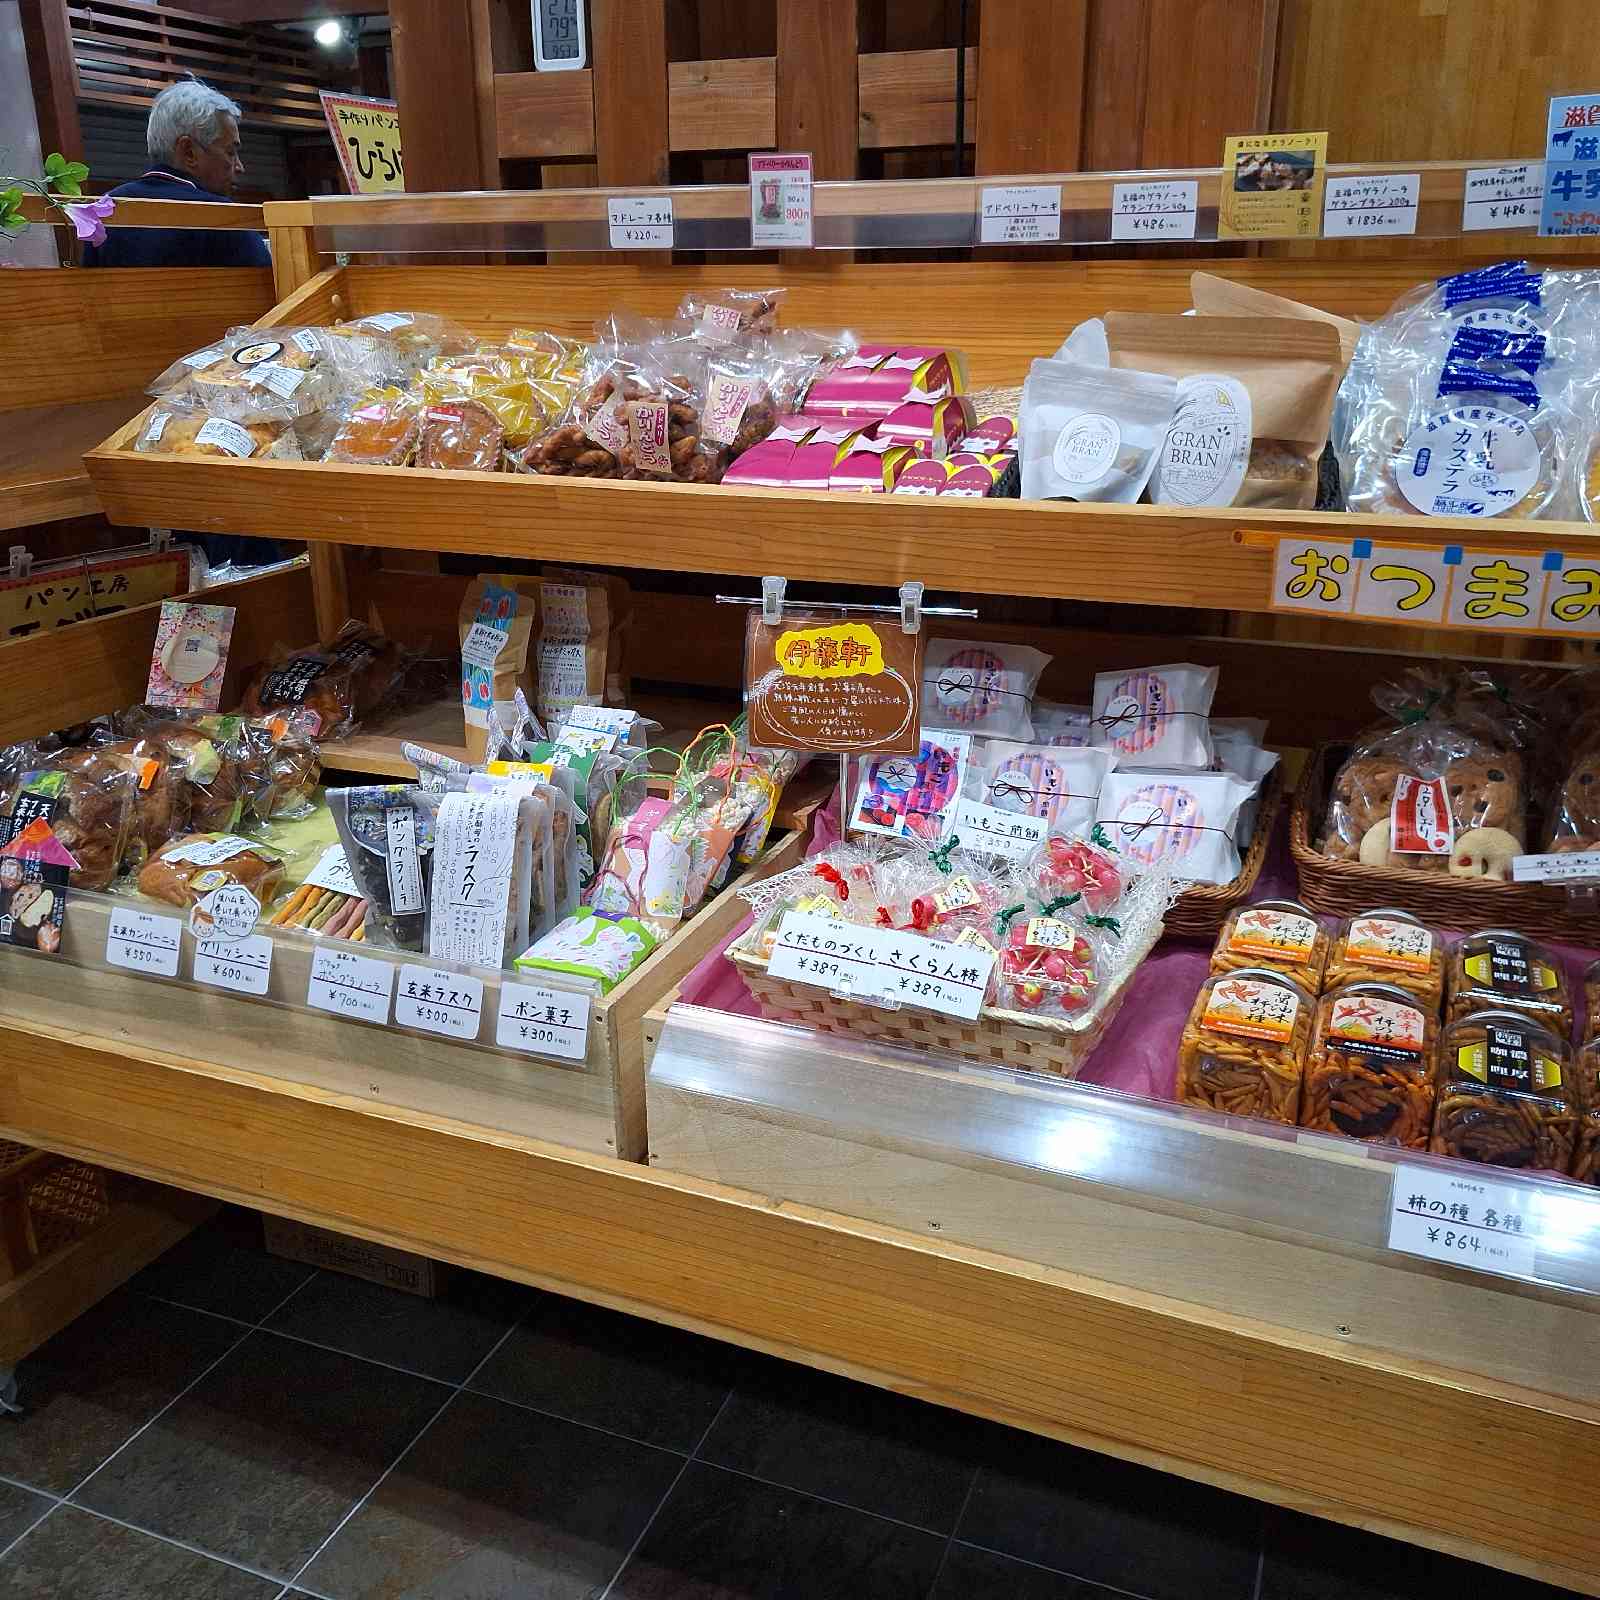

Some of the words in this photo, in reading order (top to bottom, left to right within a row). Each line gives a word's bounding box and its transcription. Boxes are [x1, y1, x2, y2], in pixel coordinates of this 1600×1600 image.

[1171, 431, 1223, 450] GRAN
[1170, 448, 1220, 467] BRAN
[1440, 428, 1472, 495] カステラ
[25, 574, 129, 610] パン工房
[391, 815, 409, 905] ポングラノーラ
[460, 844, 479, 901] ラスク
[112, 925, 177, 947] 玄米カンパーニュ
[782, 931, 878, 962] くだものづくし
[125, 947, 153, 963] ¥550
[200, 940, 268, 964] グリッシーニ
[212, 963, 241, 980] ¥600
[798, 957, 840, 977] ¥389
[889, 948, 981, 986] さくらん棒
[328, 988, 358, 1009] ¥700
[407, 981, 474, 1007] 玄米ラスク
[899, 976, 943, 999] ¥389
[415, 1006, 449, 1024] ¥500
[514, 1001, 574, 1025] ポン菓子
[519, 1025, 553, 1043] ¥300
[1408, 1194, 1470, 1222] 柿の種
[1483, 1208, 1525, 1233] 各種
[1426, 1226, 1481, 1251] ¥864
